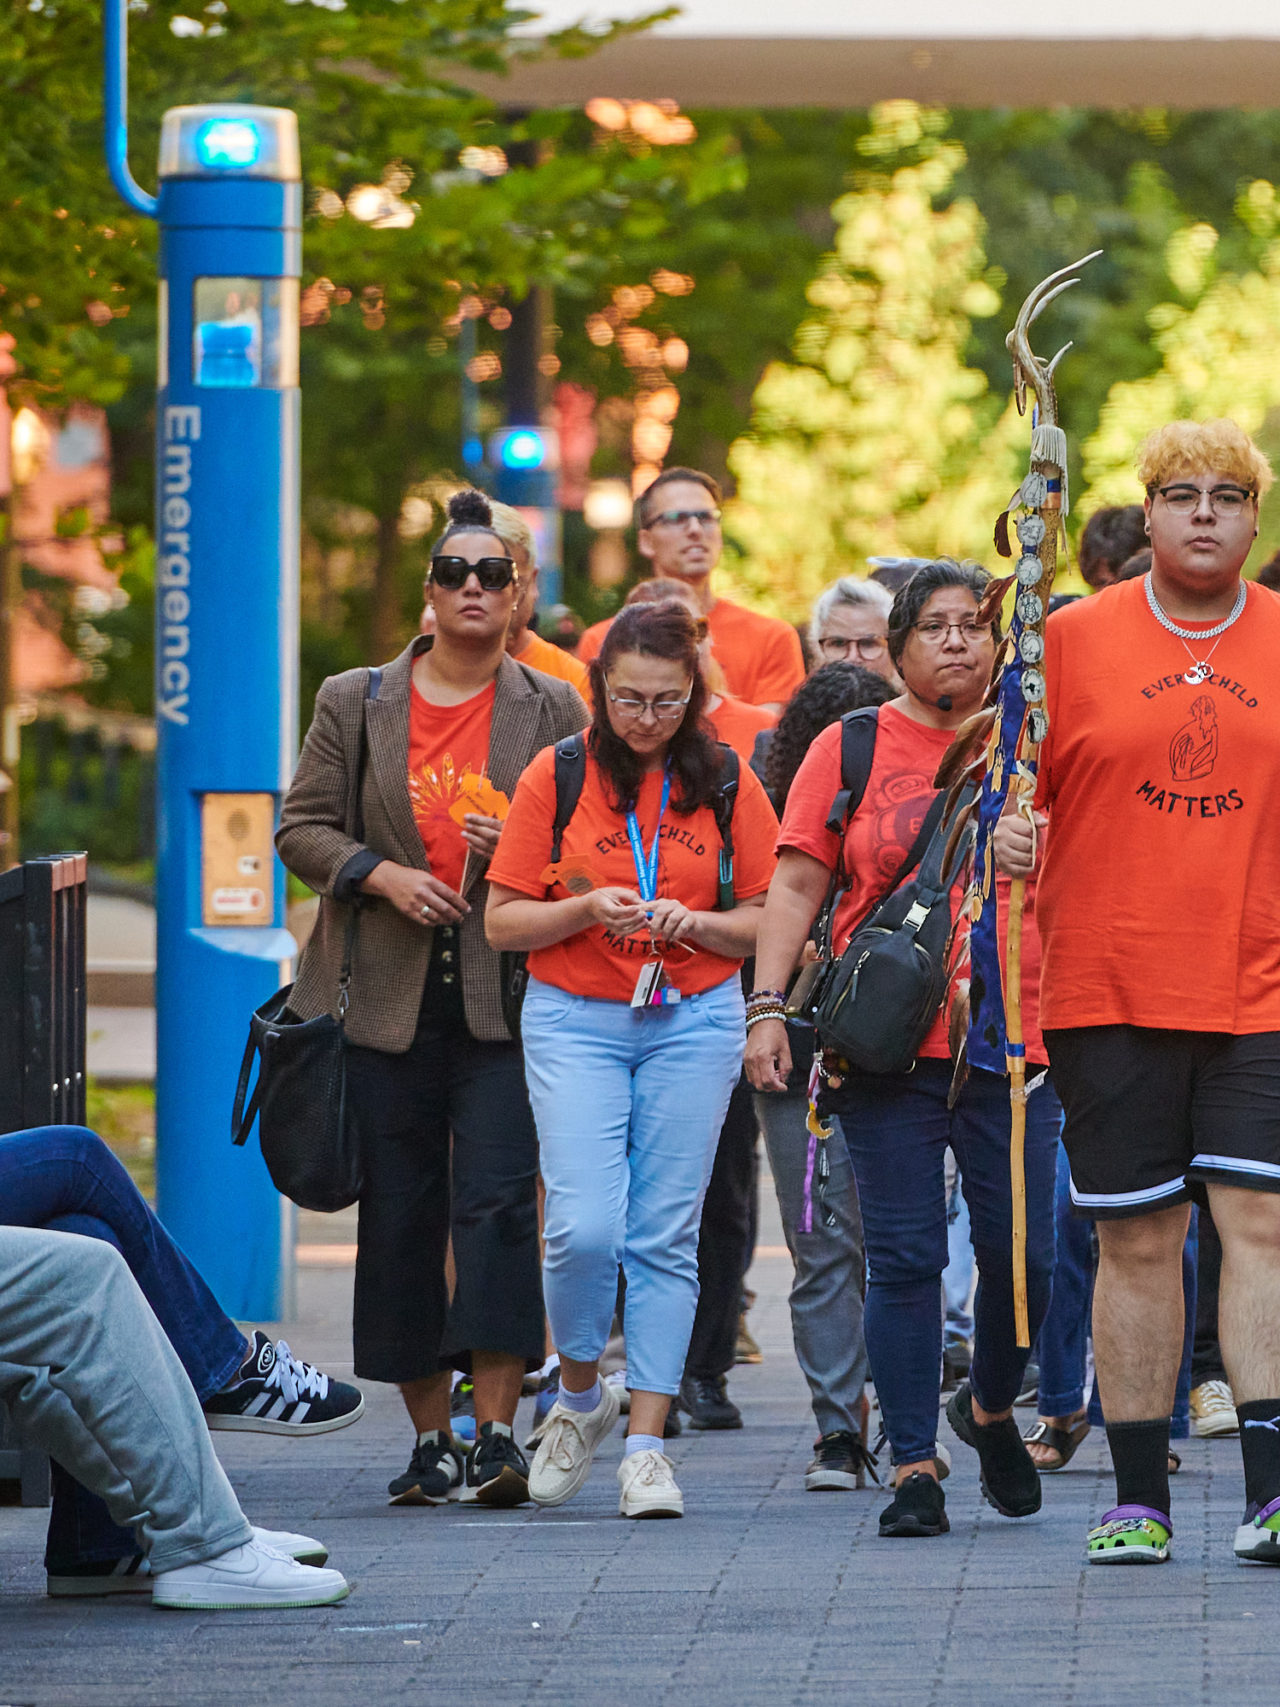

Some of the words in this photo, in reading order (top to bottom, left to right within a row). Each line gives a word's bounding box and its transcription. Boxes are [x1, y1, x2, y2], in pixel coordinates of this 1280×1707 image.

[159, 405, 201, 725] Emergency
[1140, 673, 1195, 700] EVER
[1208, 673, 1258, 708] CHILD
[1136, 780, 1244, 818] MATTERS
[596, 824, 646, 855] EVEY
[659, 824, 705, 856] CHILD
[601, 929, 677, 954] MATTR
